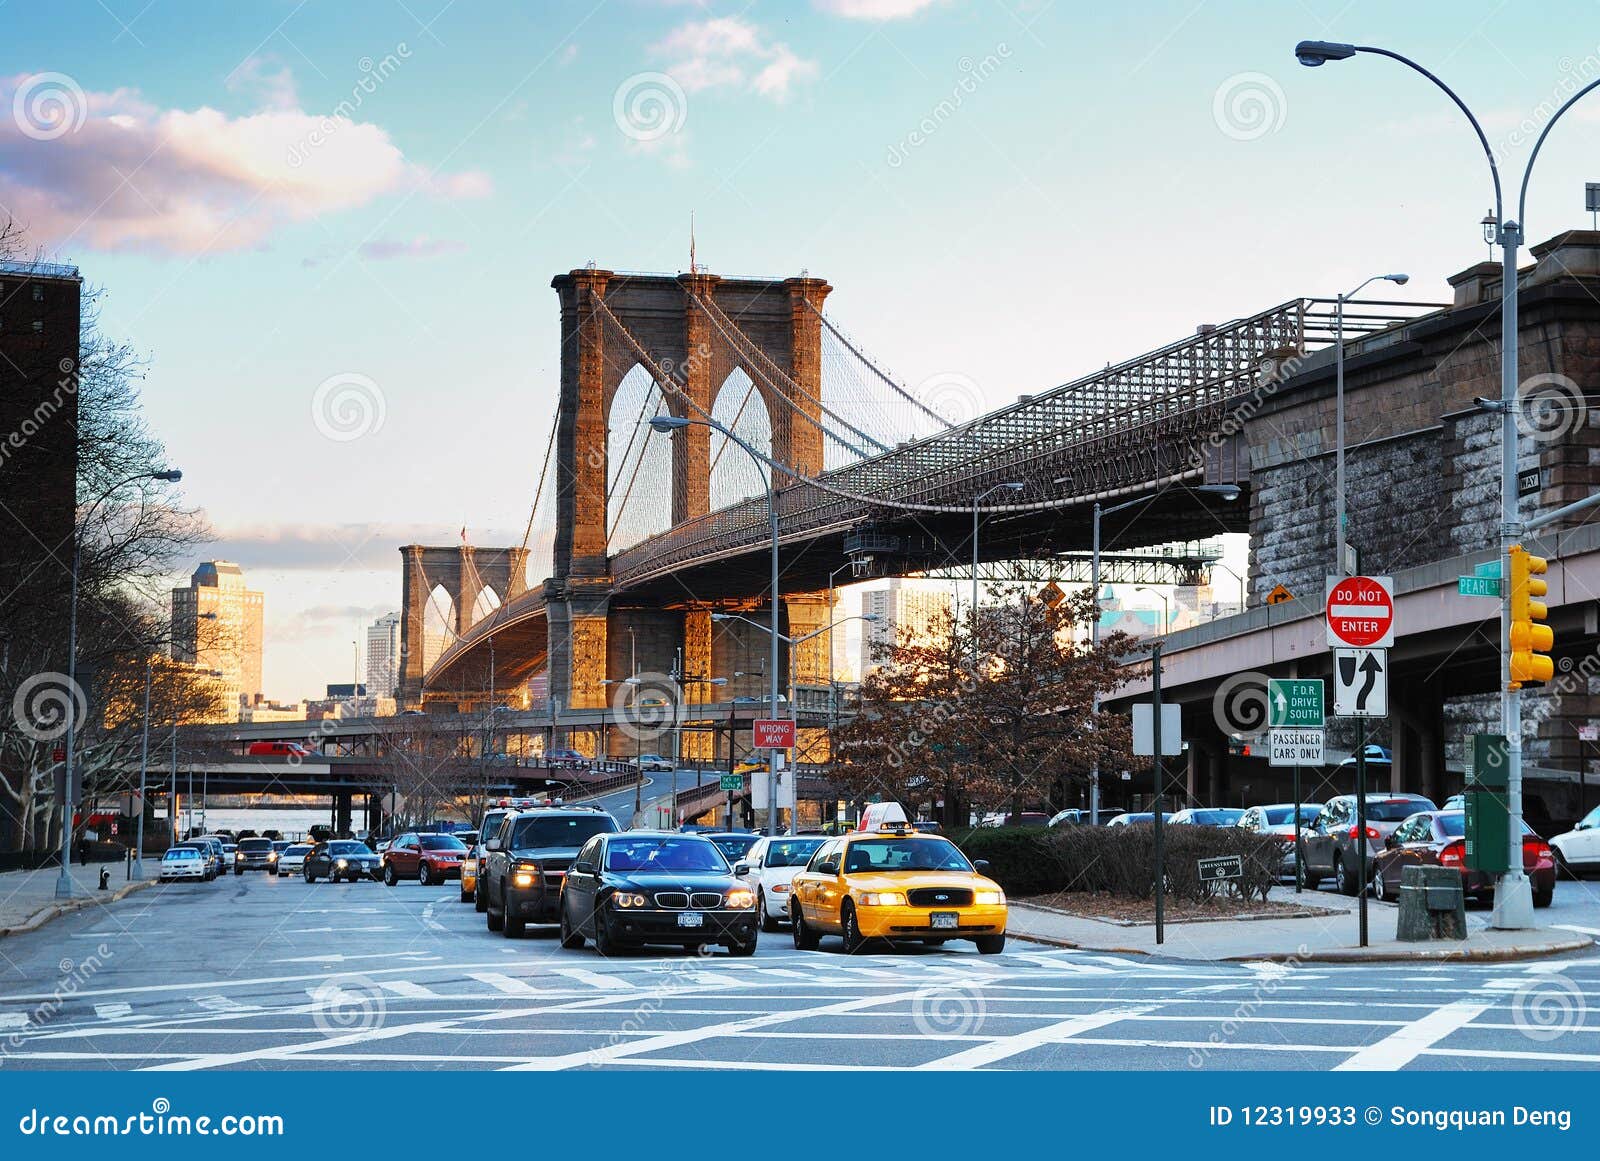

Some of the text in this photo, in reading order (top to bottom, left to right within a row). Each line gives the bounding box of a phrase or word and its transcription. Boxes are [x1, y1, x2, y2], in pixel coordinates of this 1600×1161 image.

[1520, 475, 1536, 489] WAY
[1460, 578, 1490, 594] PEARL
[1337, 590, 1381, 602] DO NOT
[1341, 621, 1378, 632] ENTER
[1291, 698, 1318, 707] DRIVE
[1290, 710, 1320, 719] SOUTH
[760, 724, 789, 734] WRONG
[765, 735, 783, 744] WAY
[1273, 734, 1320, 745] PASSENGER
[1273, 748, 1320, 759] CARS ONLY
